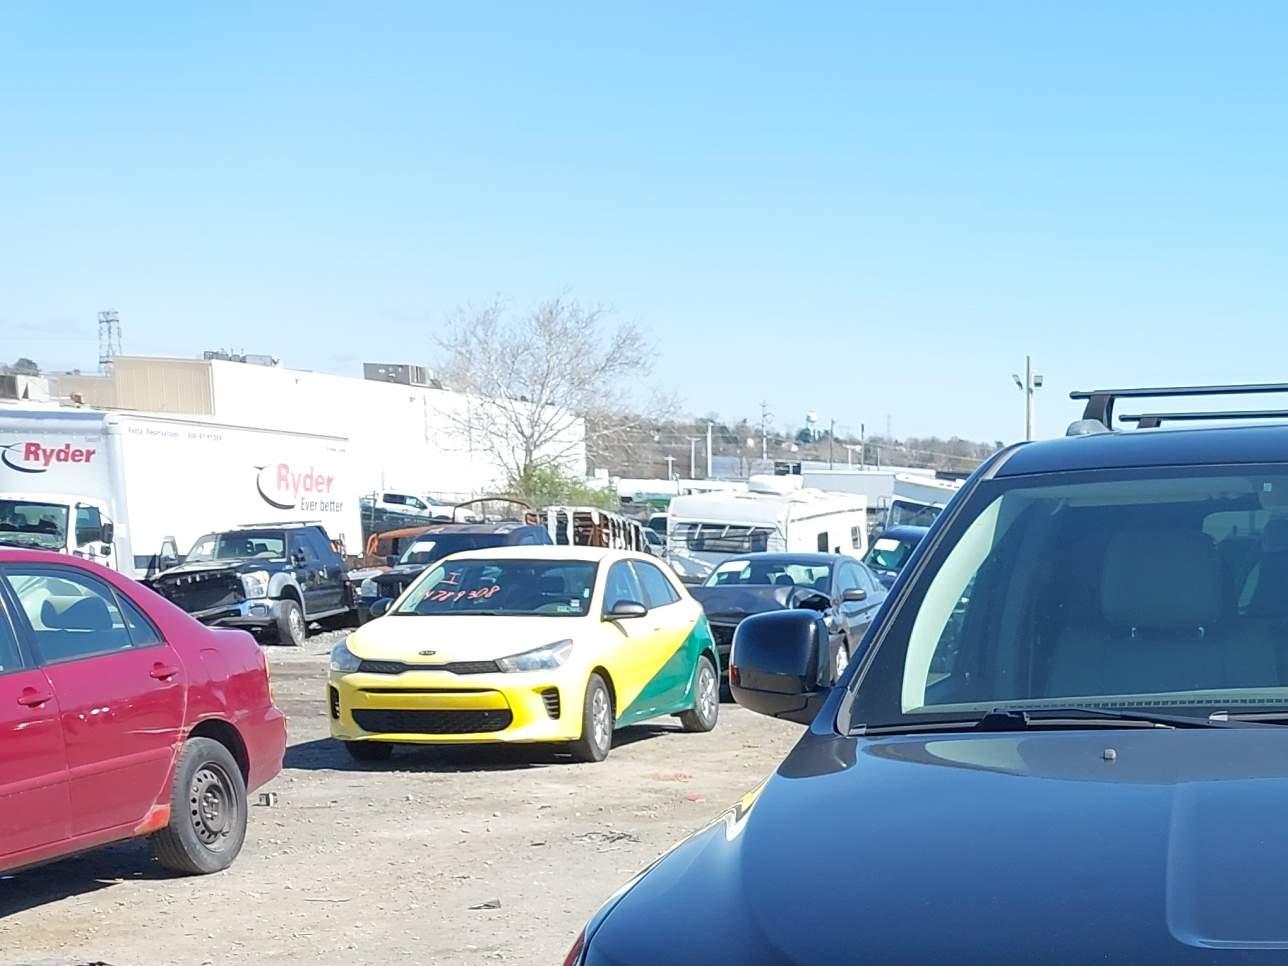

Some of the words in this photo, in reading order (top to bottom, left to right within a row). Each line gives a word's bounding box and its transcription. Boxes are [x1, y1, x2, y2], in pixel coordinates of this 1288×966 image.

[23, 442, 96, 467] Ryder
[276, 463, 334, 499] Ryder
[300, 496, 318, 511] Ever
[320, 499, 343, 512] better
